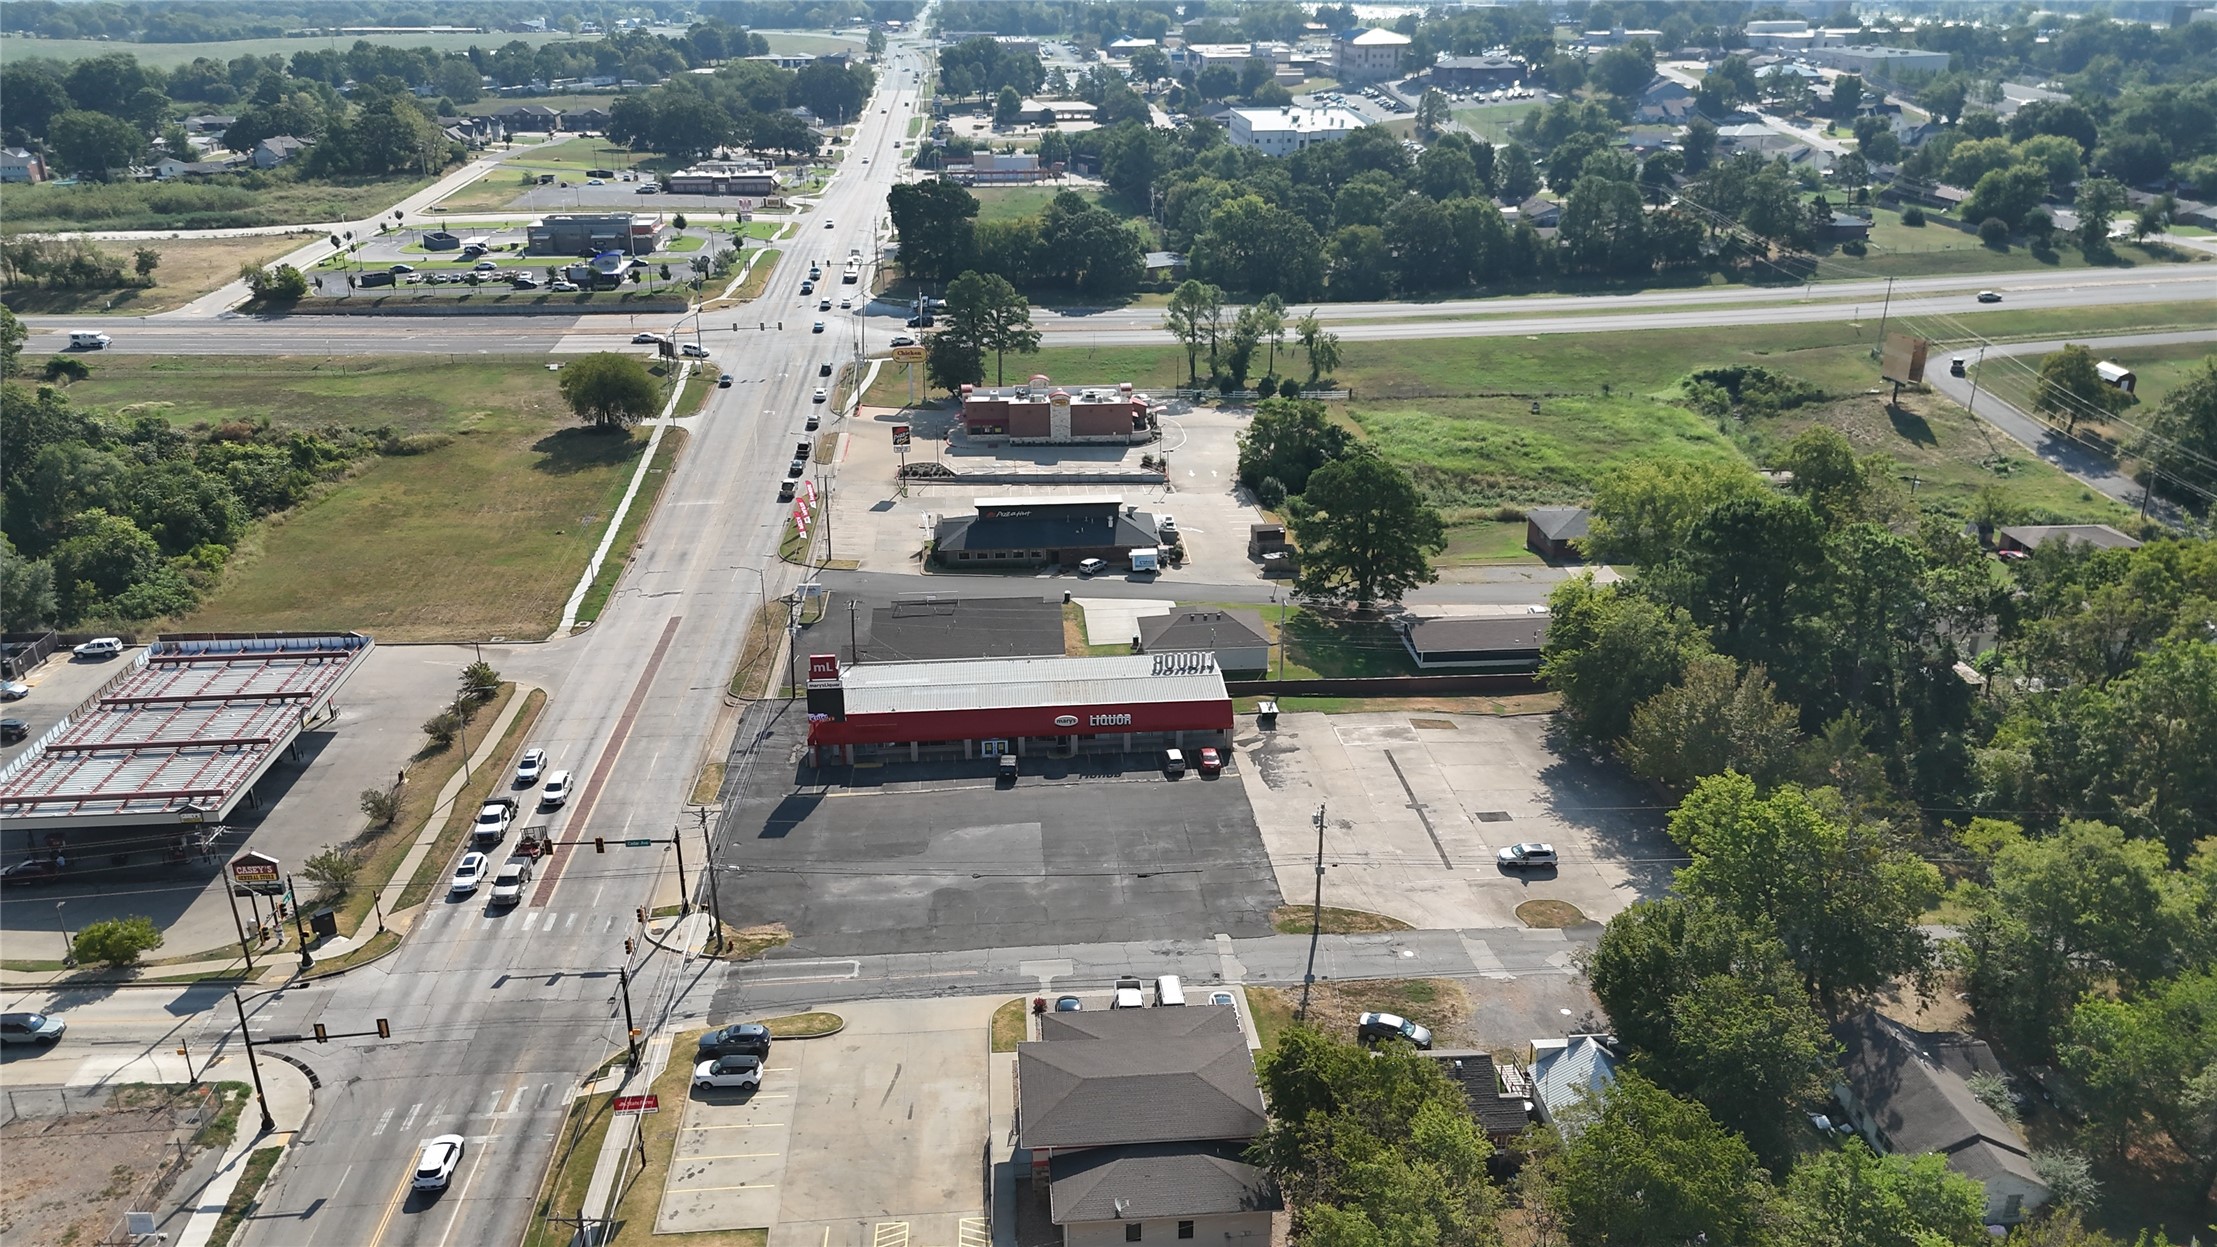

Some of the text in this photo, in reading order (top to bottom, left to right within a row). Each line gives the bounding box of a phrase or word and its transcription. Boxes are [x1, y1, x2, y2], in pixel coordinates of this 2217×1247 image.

[813, 662, 834, 672] mL
[1089, 714, 1132, 726] LIQUOR
[236, 865, 273, 875] CASEY'S
